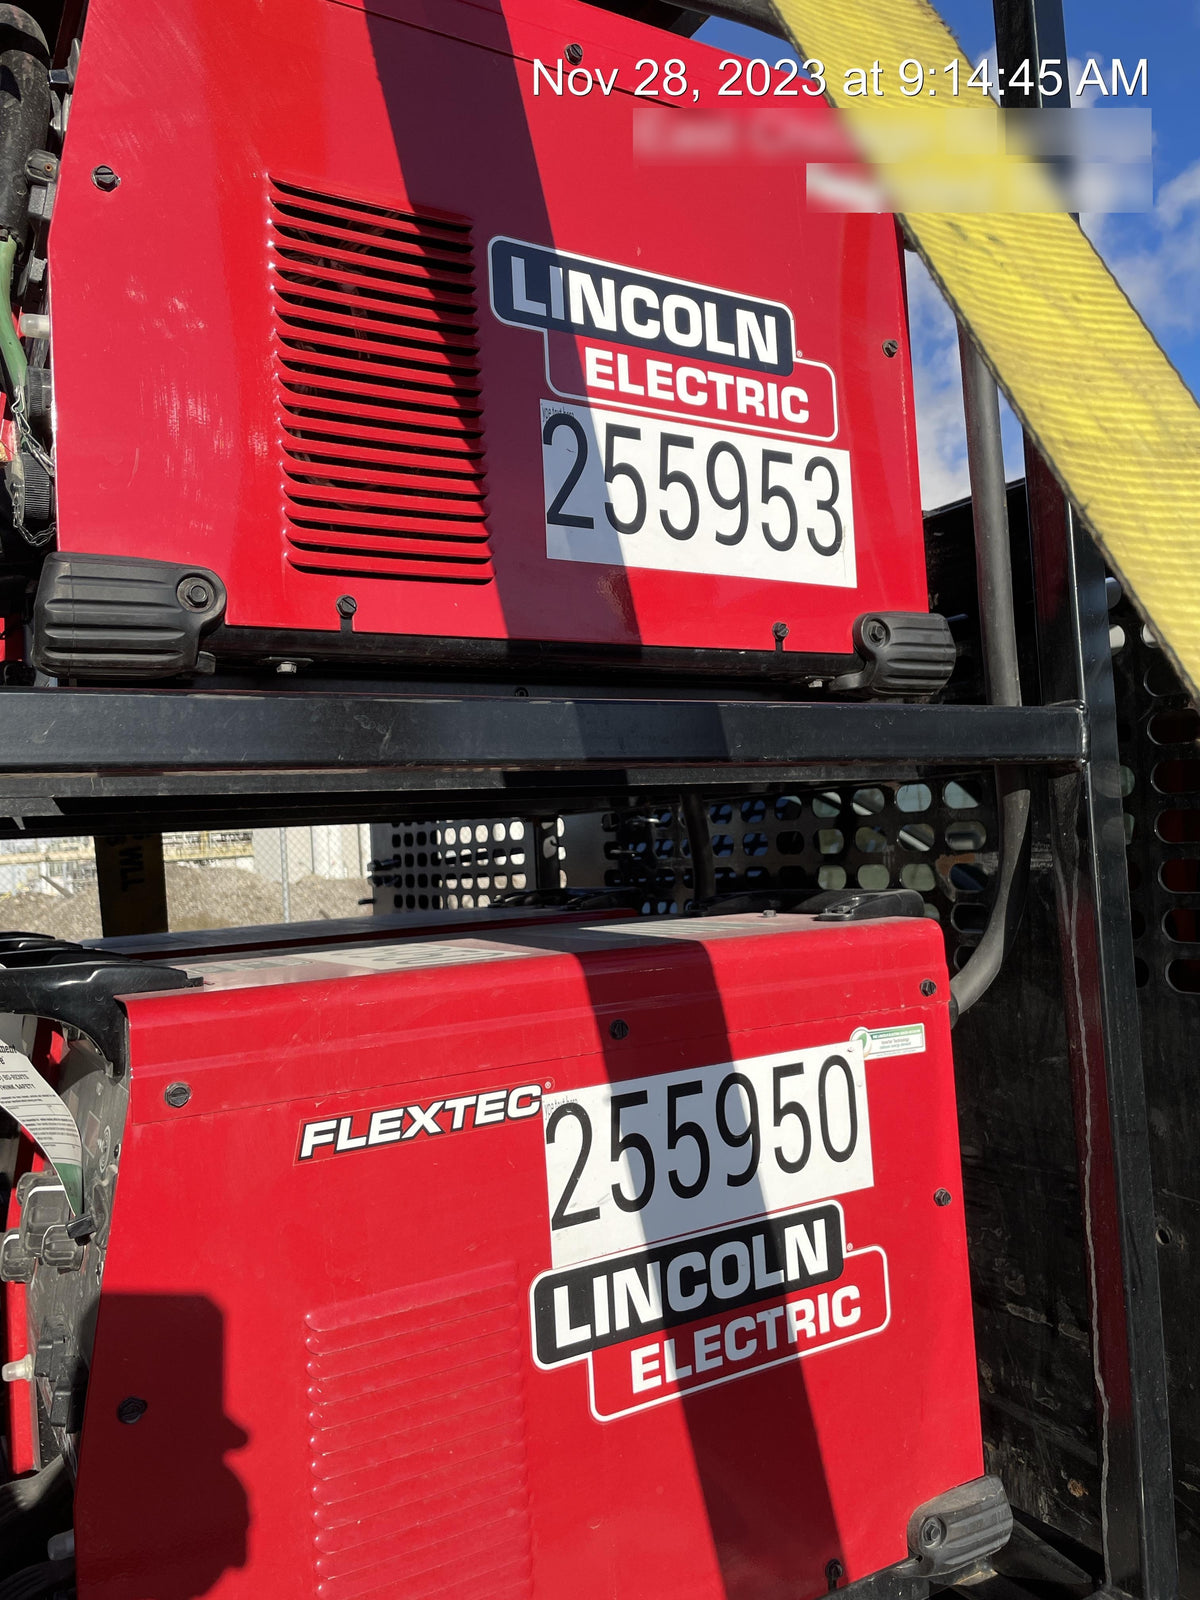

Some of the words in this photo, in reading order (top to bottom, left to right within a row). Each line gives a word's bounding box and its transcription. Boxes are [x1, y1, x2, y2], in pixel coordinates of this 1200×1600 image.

[511, 255, 779, 365] LINCOLN
[584, 346, 810, 424] ELECTRIC
[542, 414, 844, 557] 255953
[546, 1055, 858, 1231] 255950
[553, 1218, 829, 1349] LINCOLN
[630, 1285, 861, 1395] ELECTRIC
